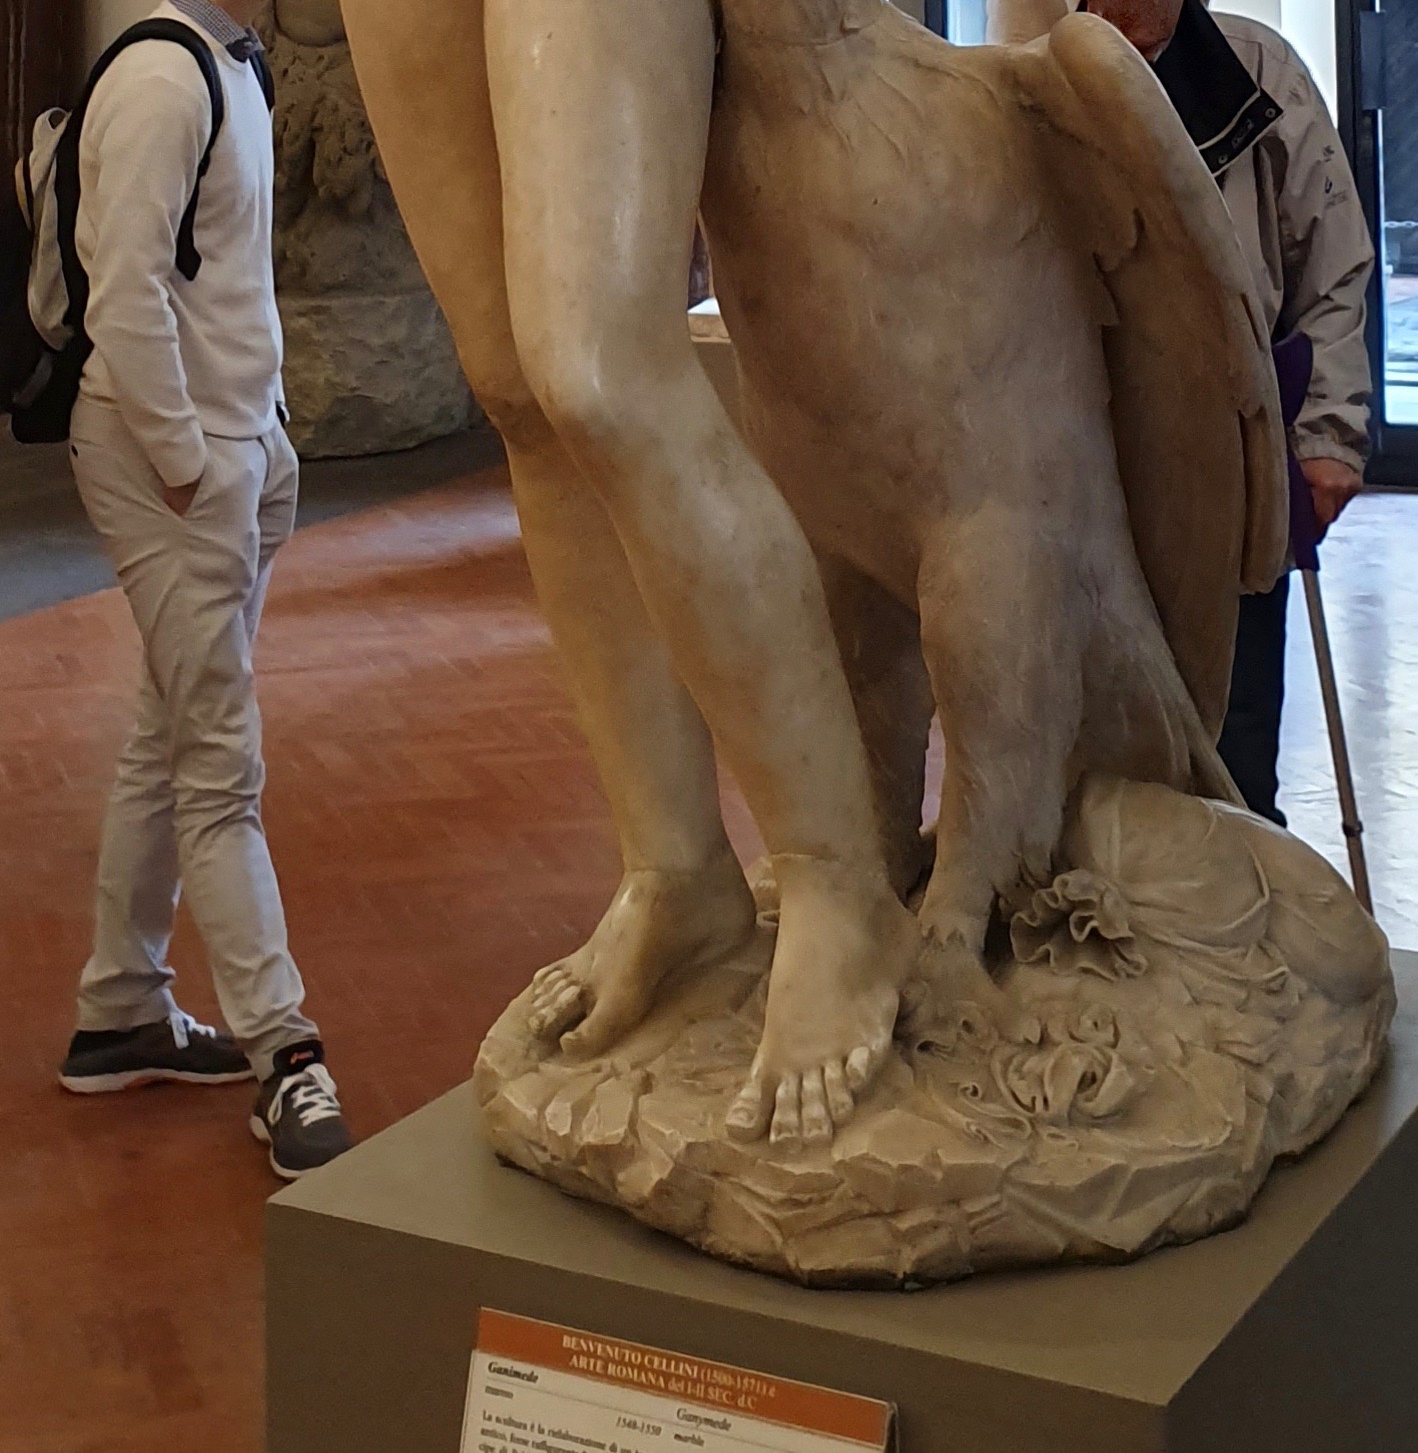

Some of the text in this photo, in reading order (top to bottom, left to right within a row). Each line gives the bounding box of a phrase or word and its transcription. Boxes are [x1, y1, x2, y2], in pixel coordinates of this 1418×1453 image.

[562, 1335, 641, 1365] BENVENUTO
[644, 1354, 698, 1378] CELLINI
[488, 1361, 539, 1383] Ganimede
[569, 1354, 604, 1373] ARTE
[607, 1362, 665, 1388] ROMANA
[677, 1408, 731, 1431] Ganymede
